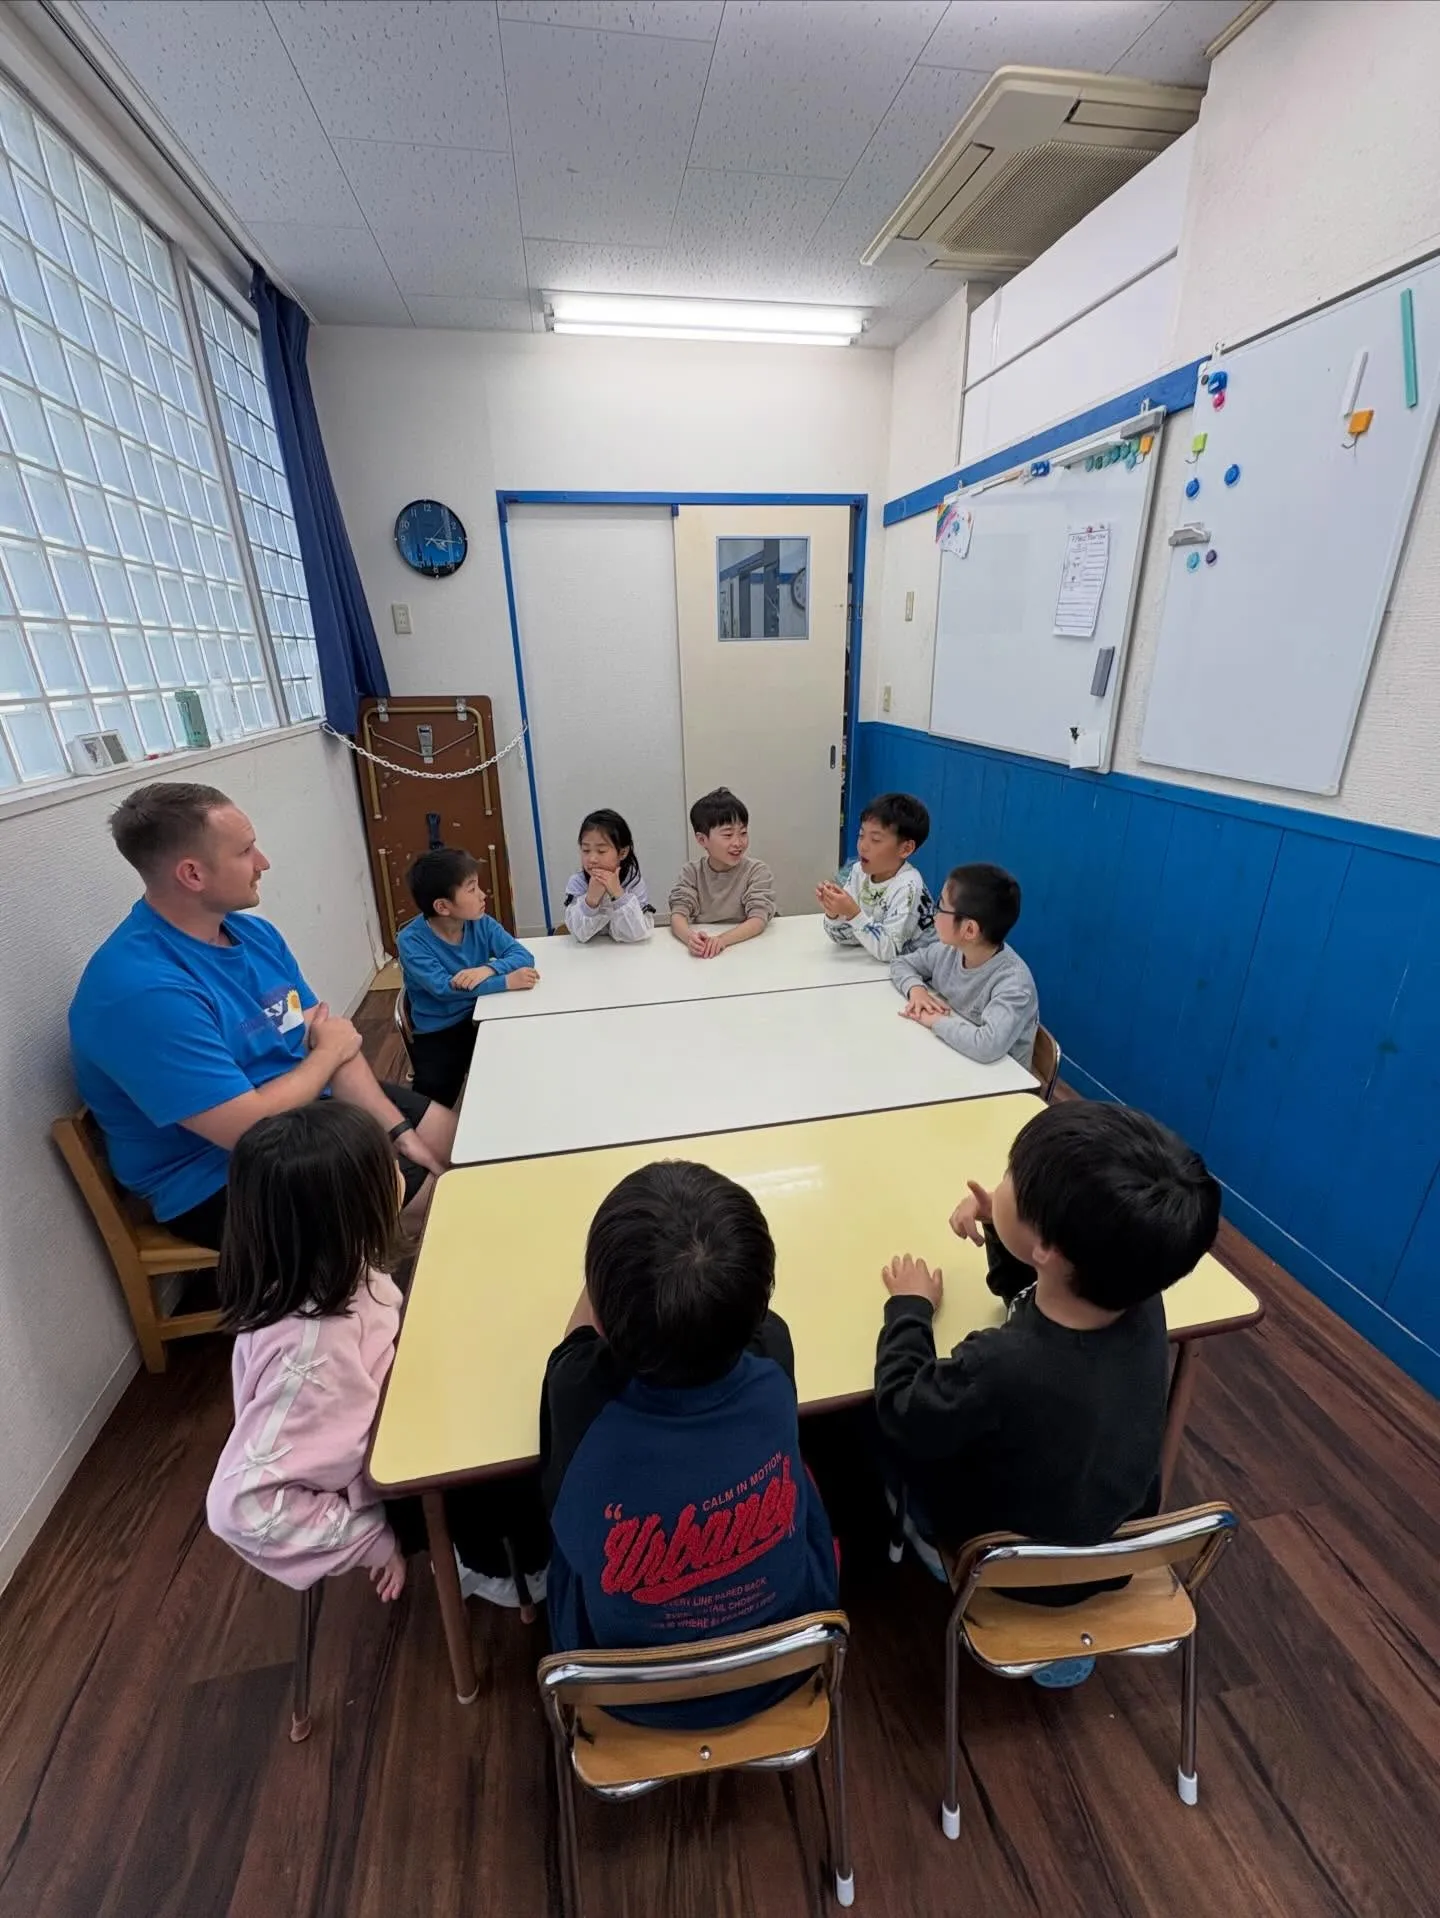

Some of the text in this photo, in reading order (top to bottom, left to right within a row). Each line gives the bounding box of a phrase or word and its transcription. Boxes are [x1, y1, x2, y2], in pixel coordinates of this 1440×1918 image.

[702, 1450, 782, 1512] CALM IN MOTION
[693, 1595, 713, 1607] LINE
